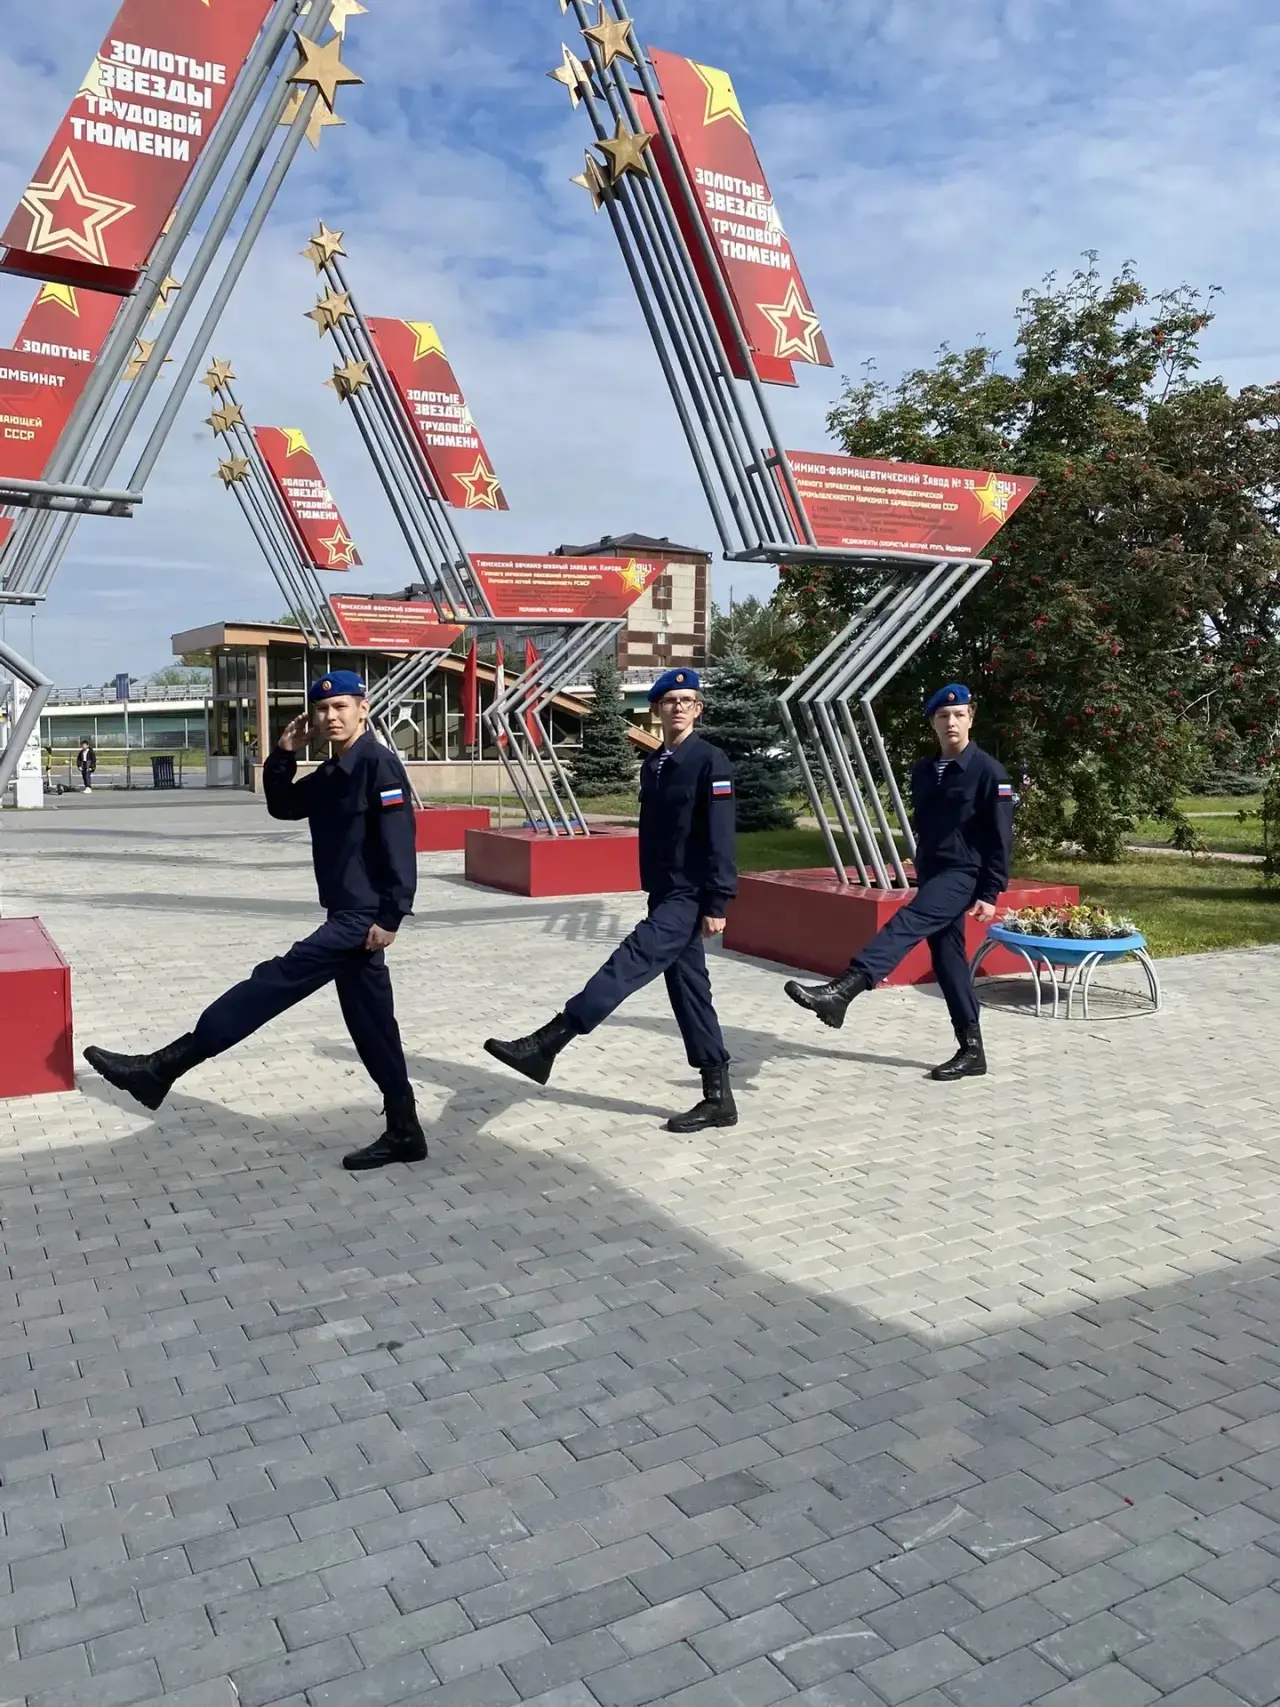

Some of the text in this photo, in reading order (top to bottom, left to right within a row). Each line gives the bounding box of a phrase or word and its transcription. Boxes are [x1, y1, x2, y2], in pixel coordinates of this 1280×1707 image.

[110, 39, 226, 85] ЗОЛОТЫЕ
[98, 63, 213, 110] ЗВЕЗДЫ
[85, 94, 203, 137] ТРУДОВОЙ
[70, 117, 190, 162] ТЮМЕНИ
[695, 167, 764, 201] ЗОЛОТЫЕ
[704, 190, 773, 221] ЗВЕЗДЫ
[712, 217, 781, 247] ТРУДОВОЙ
[720, 238, 791, 270] ТЮМЕНИ
[22, 339, 91, 362] ЗОЛОТЫЕ
[407, 389, 460, 404] ЗОЛОТЫЕ
[414, 403, 465, 418] ЗВЕЗДЫ
[4, 427, 35, 440] СССР
[419, 420, 472, 434] ТРУДОВОЙ
[426, 434, 478, 448] ТЮМЕНИ
[281, 478, 322, 487] ЗОЛОТЫЕ
[288, 488, 328, 498] ЗВЕЗДЫ
[292, 501, 332, 509] ТРУДОВОЙ
[297, 511, 338, 520] ТЮМЕНИ
